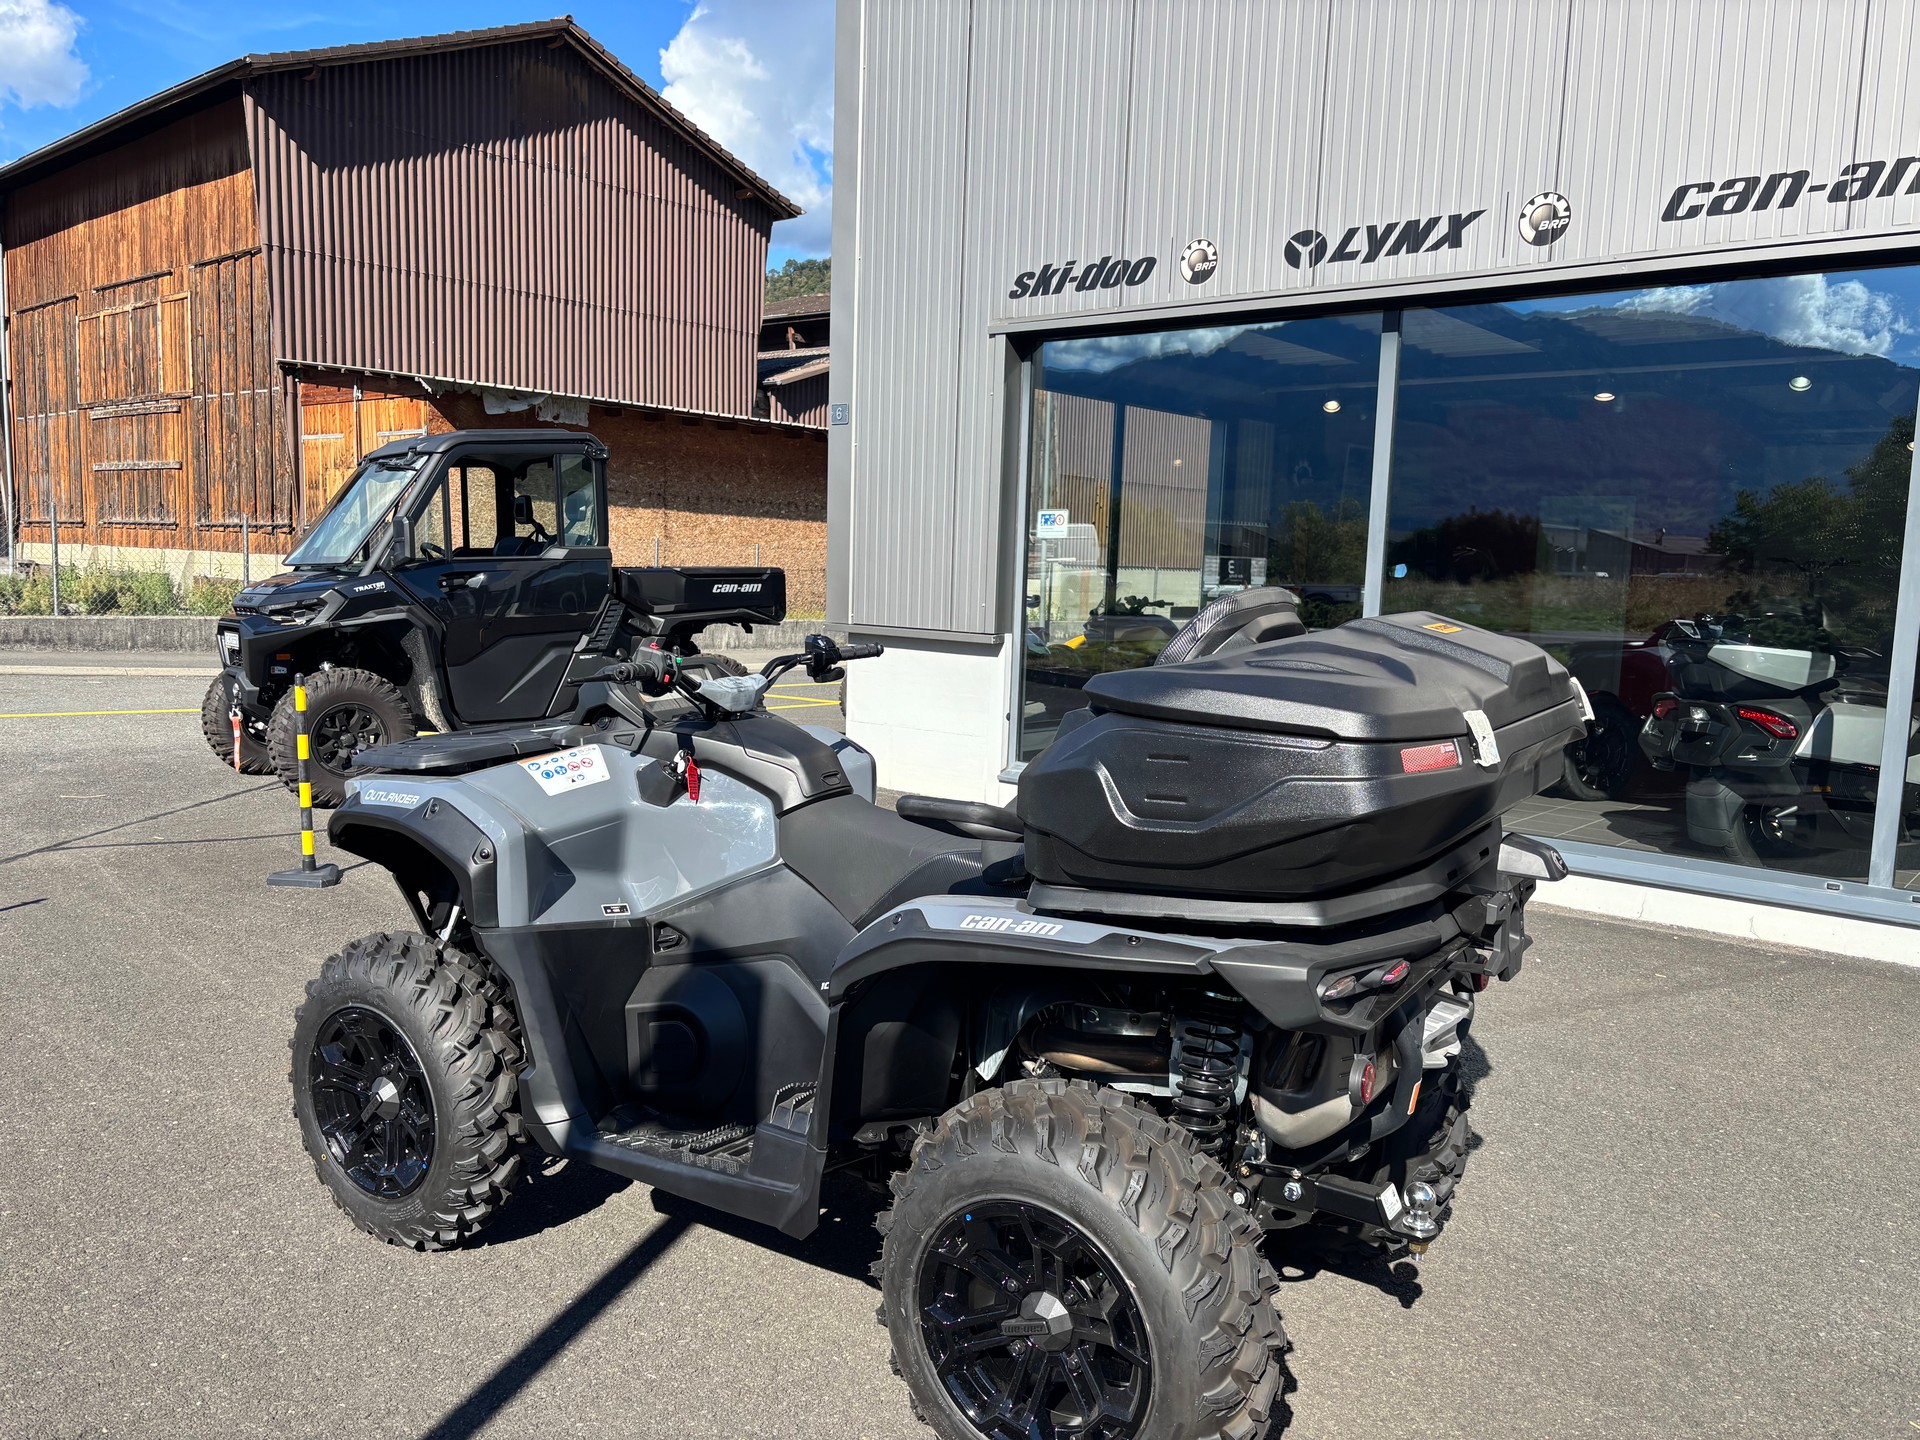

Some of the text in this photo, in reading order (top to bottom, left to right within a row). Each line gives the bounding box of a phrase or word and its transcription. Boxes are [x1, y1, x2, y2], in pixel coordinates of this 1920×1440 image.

[1538, 216, 1570, 231] BRP
[1327, 208, 1488, 264] LYNX
[1193, 260, 1217, 272] BRP
[1008, 255, 1157, 299] ski-doo
[836, 407, 843, 420] 6
[712, 583, 762, 593] can-am
[364, 789, 420, 805] OUTLANDER
[960, 914, 1064, 936] can-am
